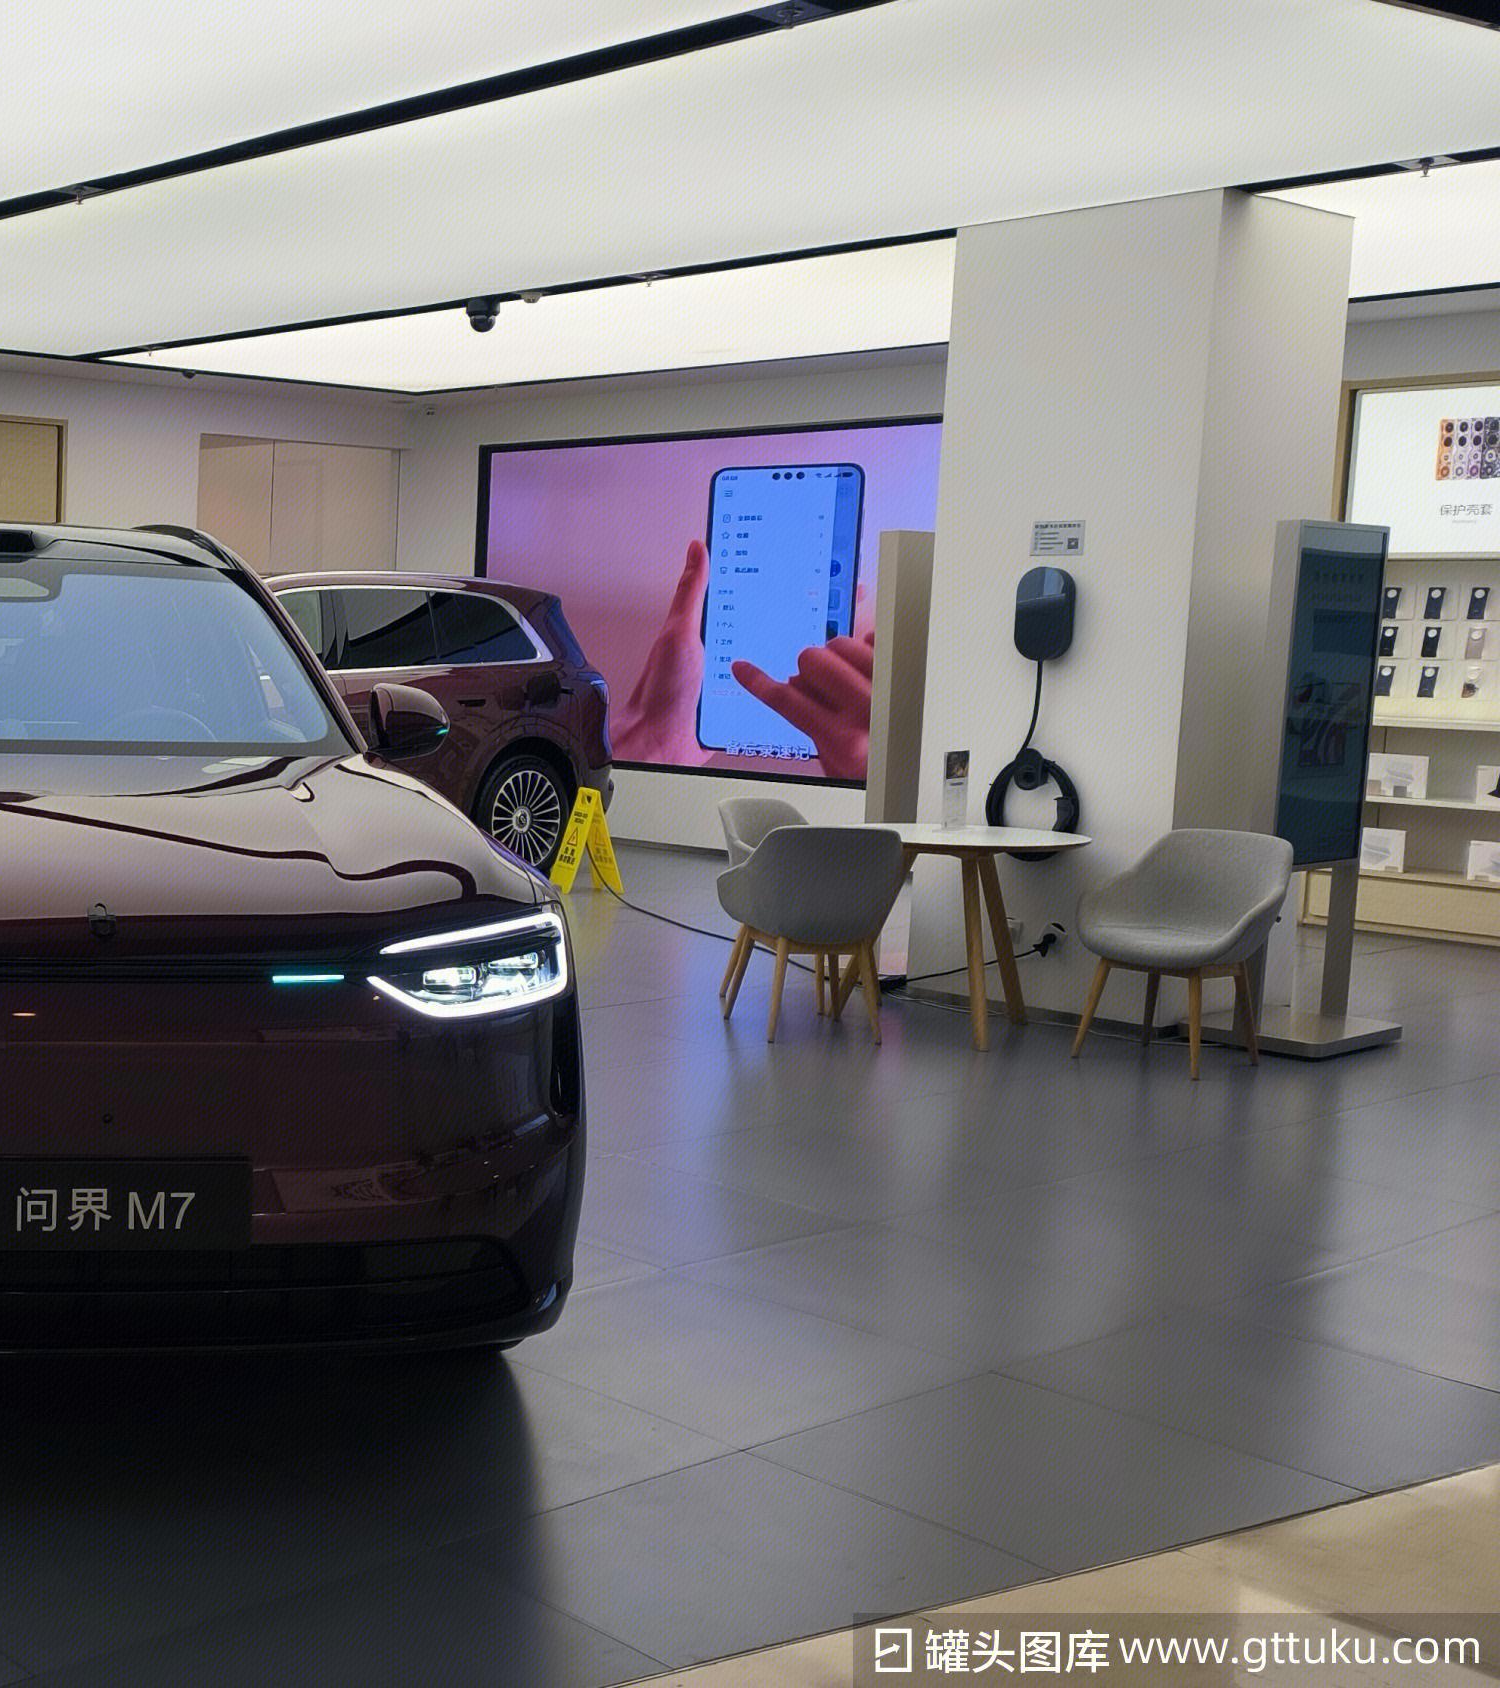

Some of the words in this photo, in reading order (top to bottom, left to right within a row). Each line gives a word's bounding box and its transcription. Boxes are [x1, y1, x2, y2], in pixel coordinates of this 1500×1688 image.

[1440, 503, 1494, 517] 保护壳套
[15, 1186, 113, 1233] 问界
[127, 1191, 197, 1231] M7
